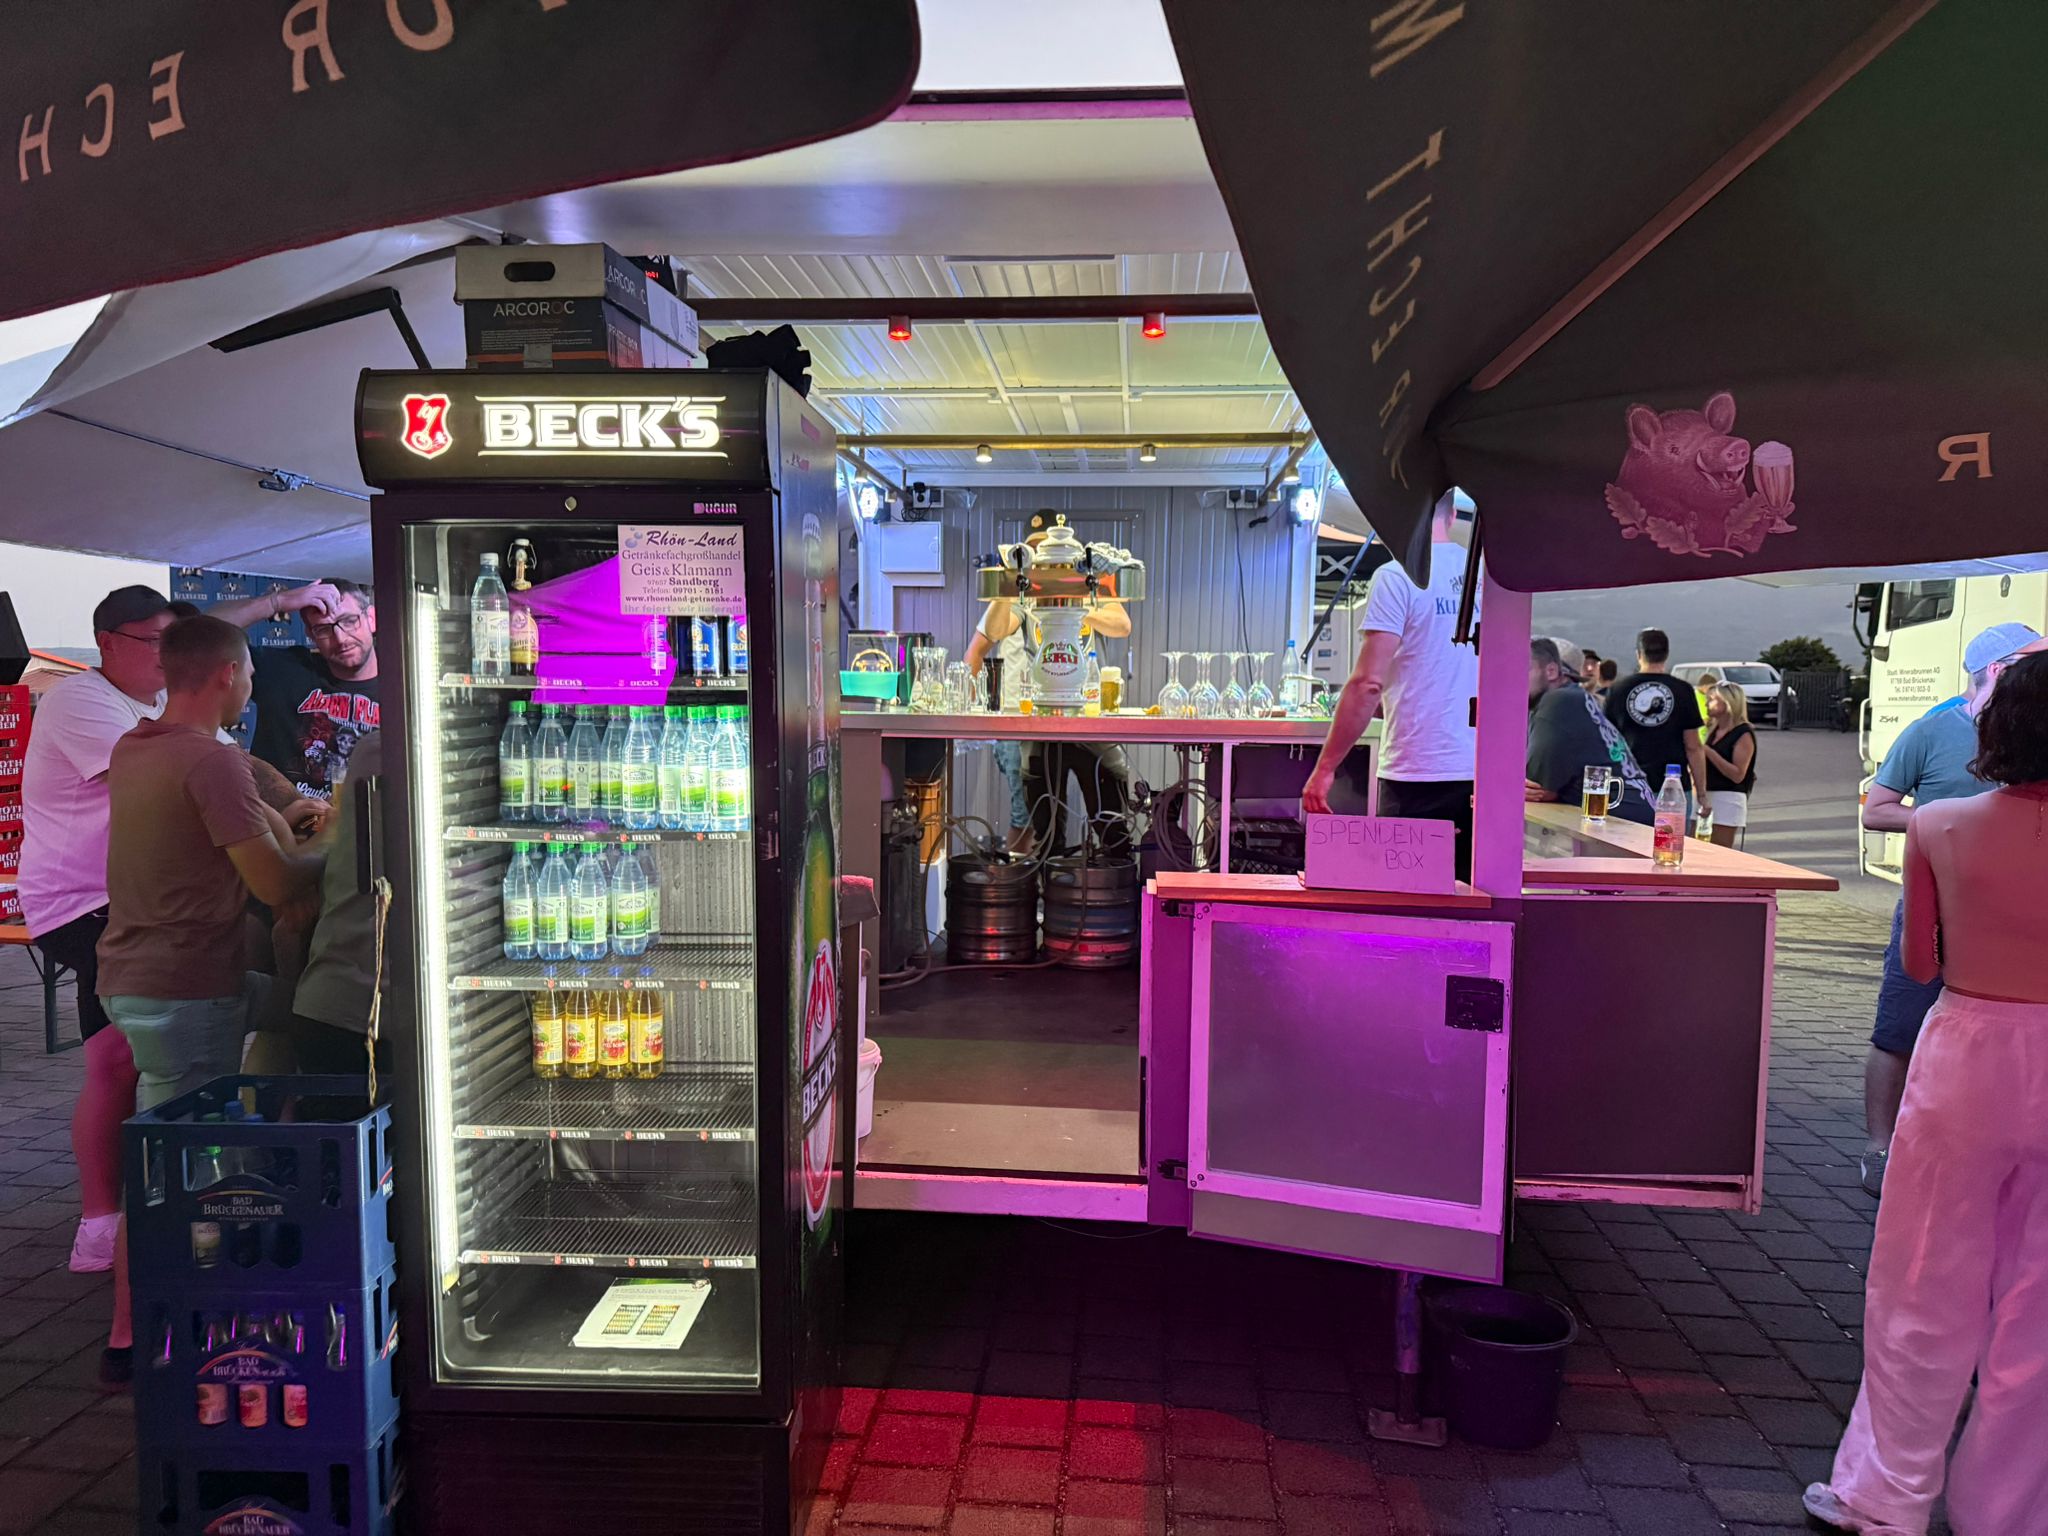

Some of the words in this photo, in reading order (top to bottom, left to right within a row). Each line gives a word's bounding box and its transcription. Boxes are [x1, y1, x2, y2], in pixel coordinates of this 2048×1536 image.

[606, 264, 647, 305] ARCORC
[493, 300, 576, 318] ARCOROC
[484, 396, 720, 449] BECK'S
[646, 531, 738, 547] Rhön-Land
[622, 549, 741, 561] Getränkefachgroßhandel
[672, 563, 733, 576] Klamann
[669, 577, 720, 588] Sandberg
[1385, 849, 1424, 870] BOX
